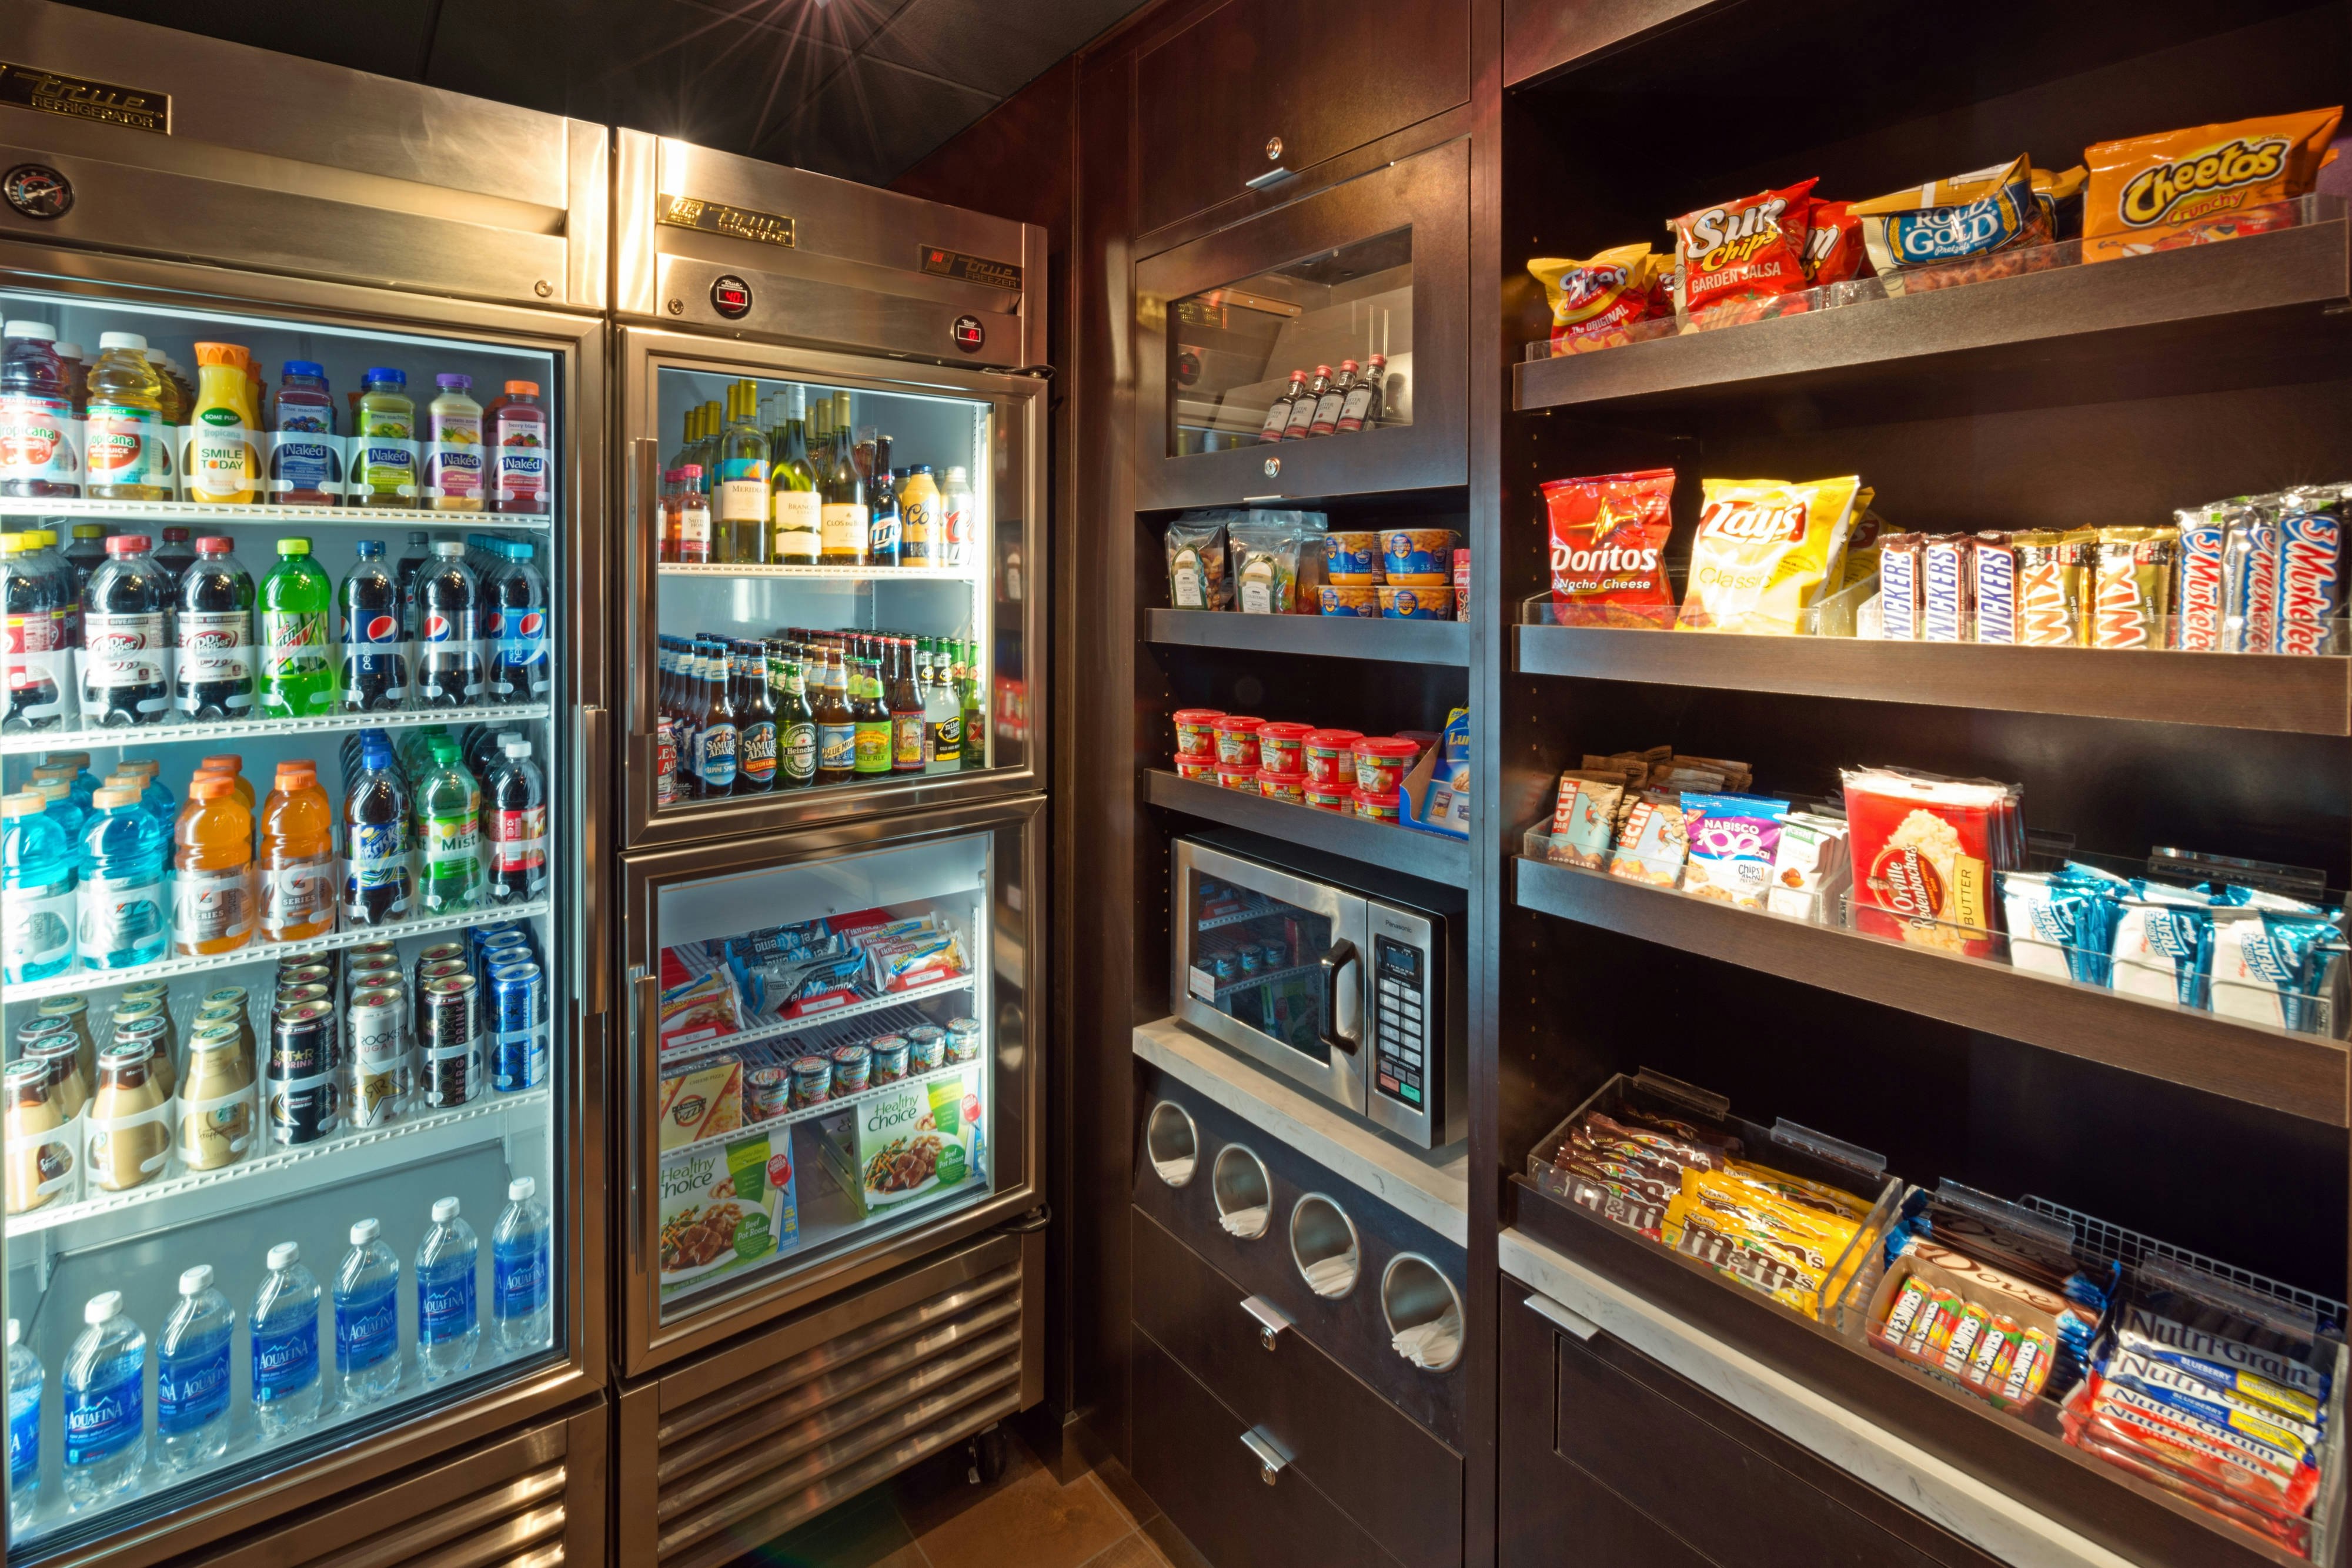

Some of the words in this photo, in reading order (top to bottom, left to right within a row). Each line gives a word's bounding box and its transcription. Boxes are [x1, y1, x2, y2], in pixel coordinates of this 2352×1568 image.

[31, 95, 153, 127] REFRIGERATOR
[2122, 142, 2287, 225] Cheetos
[1913, 198, 1990, 229] ROLD
[2168, 190, 2246, 224] Crunchy
[1685, 198, 1788, 260] Sun
[1905, 213, 1999, 255] GOLD
[1702, 224, 1778, 273] Chips
[1934, 242, 1970, 256] Pretzels
[965, 271, 1017, 287] FREEZER
[1691, 271, 1738, 294] GARDEN
[1741, 261, 1782, 280] SALSA
[1572, 326, 1585, 335] The
[1586, 304, 1629, 331] ORIGINAL
[203, 429, 241, 439] Tropicana
[201, 448, 243, 459] SMILE
[286, 444, 324, 456] Naked
[372, 449, 407, 462] Naked
[444, 454, 480, 466] Naked
[506, 457, 541, 470] Naked
[1700, 501, 1805, 544] Lay's
[2300, 520, 2338, 544] 3
[1550, 541, 1659, 571] Doritos
[1559, 577, 1598, 590] Nacho
[1602, 577, 1651, 590] Cheese
[1699, 566, 1772, 590] Classic
[1979, 548, 2012, 643] NICKERS
[706, 738, 736, 751] SAMUEL
[709, 746, 735, 758] ADAMS
[744, 738, 777, 752] SAMUEL
[747, 747, 777, 760] ADAMS
[787, 744, 816, 755] Heineken
[823, 745, 841, 758] BLUE
[1555, 782, 1580, 821] CLIF
[1553, 821, 1568, 831] BAR
[1624, 803, 1653, 838] CLIF
[1704, 819, 1759, 835] NABISCO
[442, 833, 476, 851] Mist
[1620, 835, 1638, 847] BAR
[1547, 855, 1597, 870] CHOCOLATE
[1738, 864, 1761, 875] Chips
[1886, 861, 1915, 912] Orville
[1902, 844, 1939, 931] Redenbacher's
[1961, 868, 1975, 927] BUTTER
[283, 894, 316, 905] SERIES
[1385, 920, 1413, 934] Panasonic
[2154, 909, 2185, 958] TREATS
[881, 947, 893, 955] HOT
[2250, 932, 2290, 982] TREATS
[456, 1004, 465, 1044] DRINK
[689, 1077, 709, 1085] CHEESE
[710, 1073, 724, 1081] PIZZA
[875, 1094, 919, 1116] Healthy
[867, 1107, 917, 1132] Choice
[939, 1160, 949, 1169] Pot
[948, 1155, 964, 1165] Roast
[944, 1149, 957, 1160] Beef
[662, 1156, 716, 1183] Healthy
[1579, 1167, 1602, 1181] CHOCOLATE
[1723, 1166, 1750, 1178] PEANUT
[1704, 1189, 1732, 1202] PEANUT
[745, 1216, 761, 1229] Beef
[1689, 1212, 1716, 1228] PEANUT
[737, 1231, 749, 1242] Pot
[750, 1225, 769, 1237] Roast
[505, 1266, 546, 1290] AQUAFINA
[1914, 1241, 2053, 1308] Dove
[422, 1292, 465, 1315] AQUAFINA
[348, 1311, 393, 1342] AQUAFINA
[259, 1341, 309, 1370] AQUAFINA
[2130, 1308, 2312, 1387] Nutri-Grain
[2181, 1356, 2231, 1382] BLUEBERRY
[68, 1400, 123, 1430] AQUAFINA
[2173, 1392, 2224, 1417] BLUEBERRY
[2149, 1412, 2227, 1446] STRAWBERRY
[2138, 1427, 2214, 1459] STRAWBERRY
